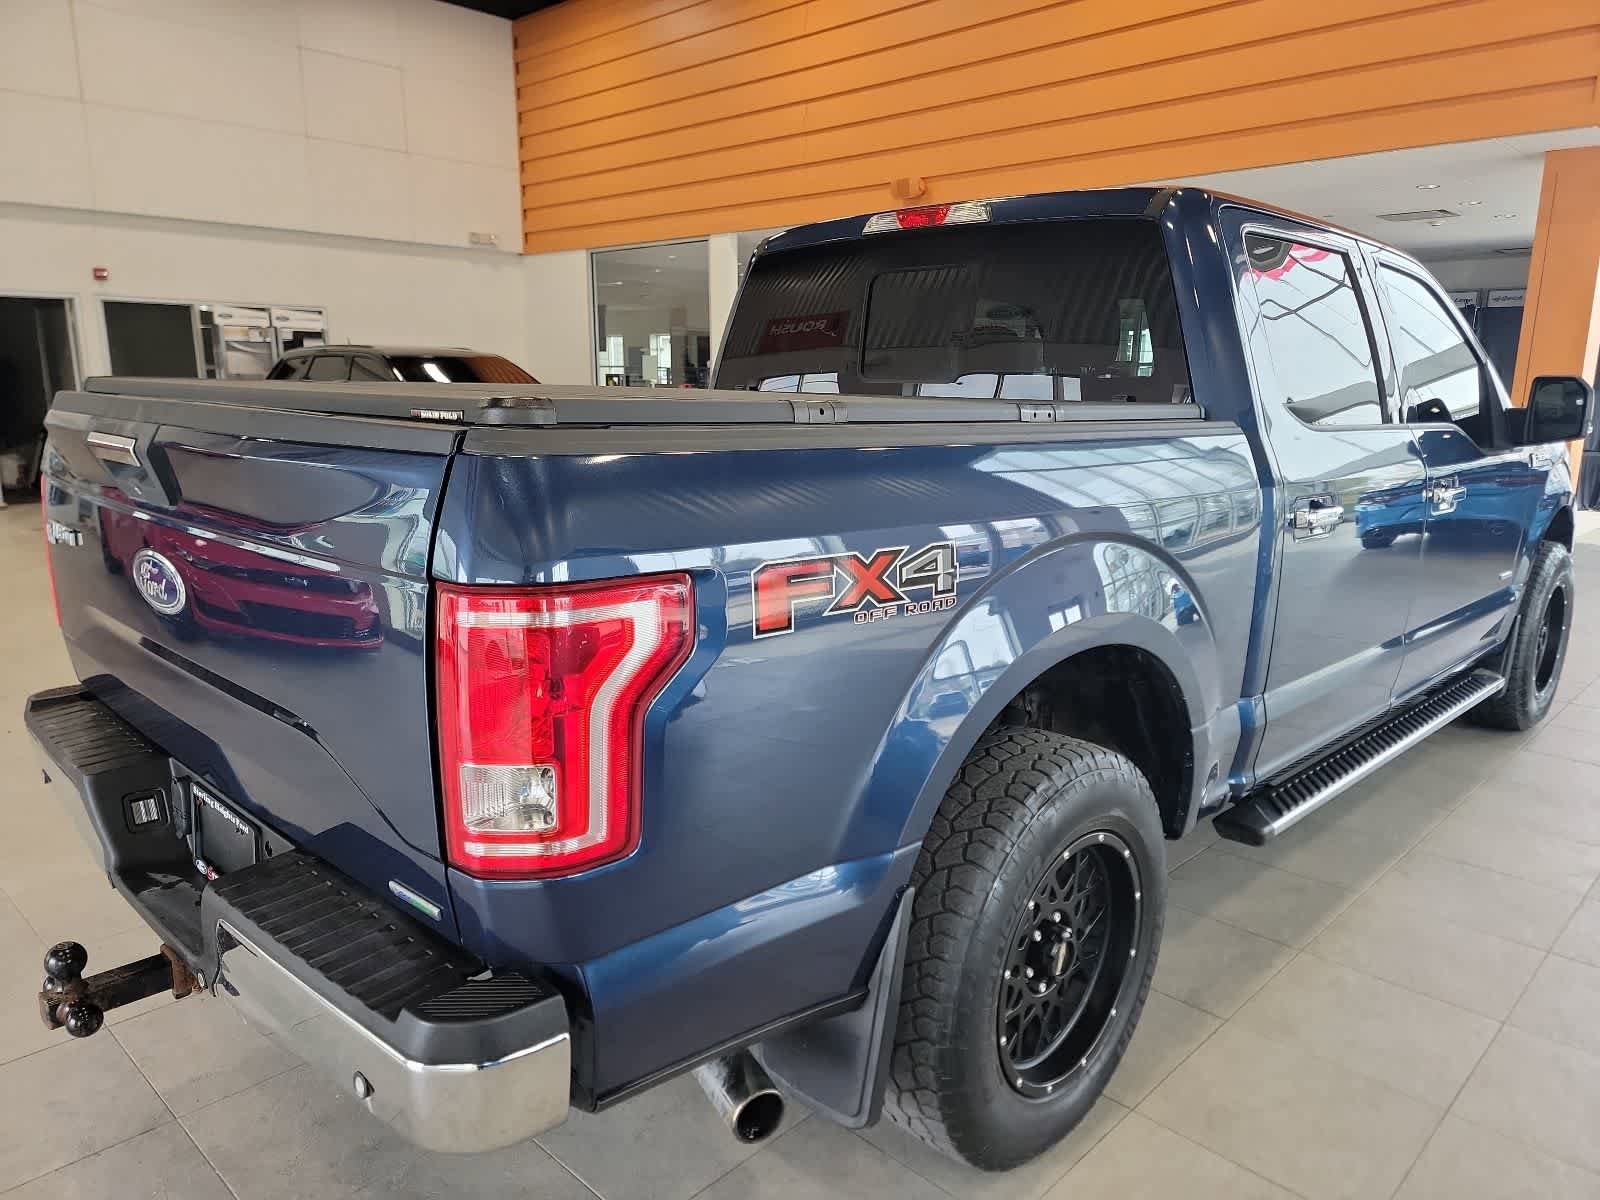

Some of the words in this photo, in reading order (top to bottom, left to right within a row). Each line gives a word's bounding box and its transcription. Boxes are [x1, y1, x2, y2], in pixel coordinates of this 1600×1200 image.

[139, 560, 168, 601] Ford
[752, 541, 959, 639] FX4
[854, 606, 897, 624] OFF
[904, 597, 957, 617] ROAD
